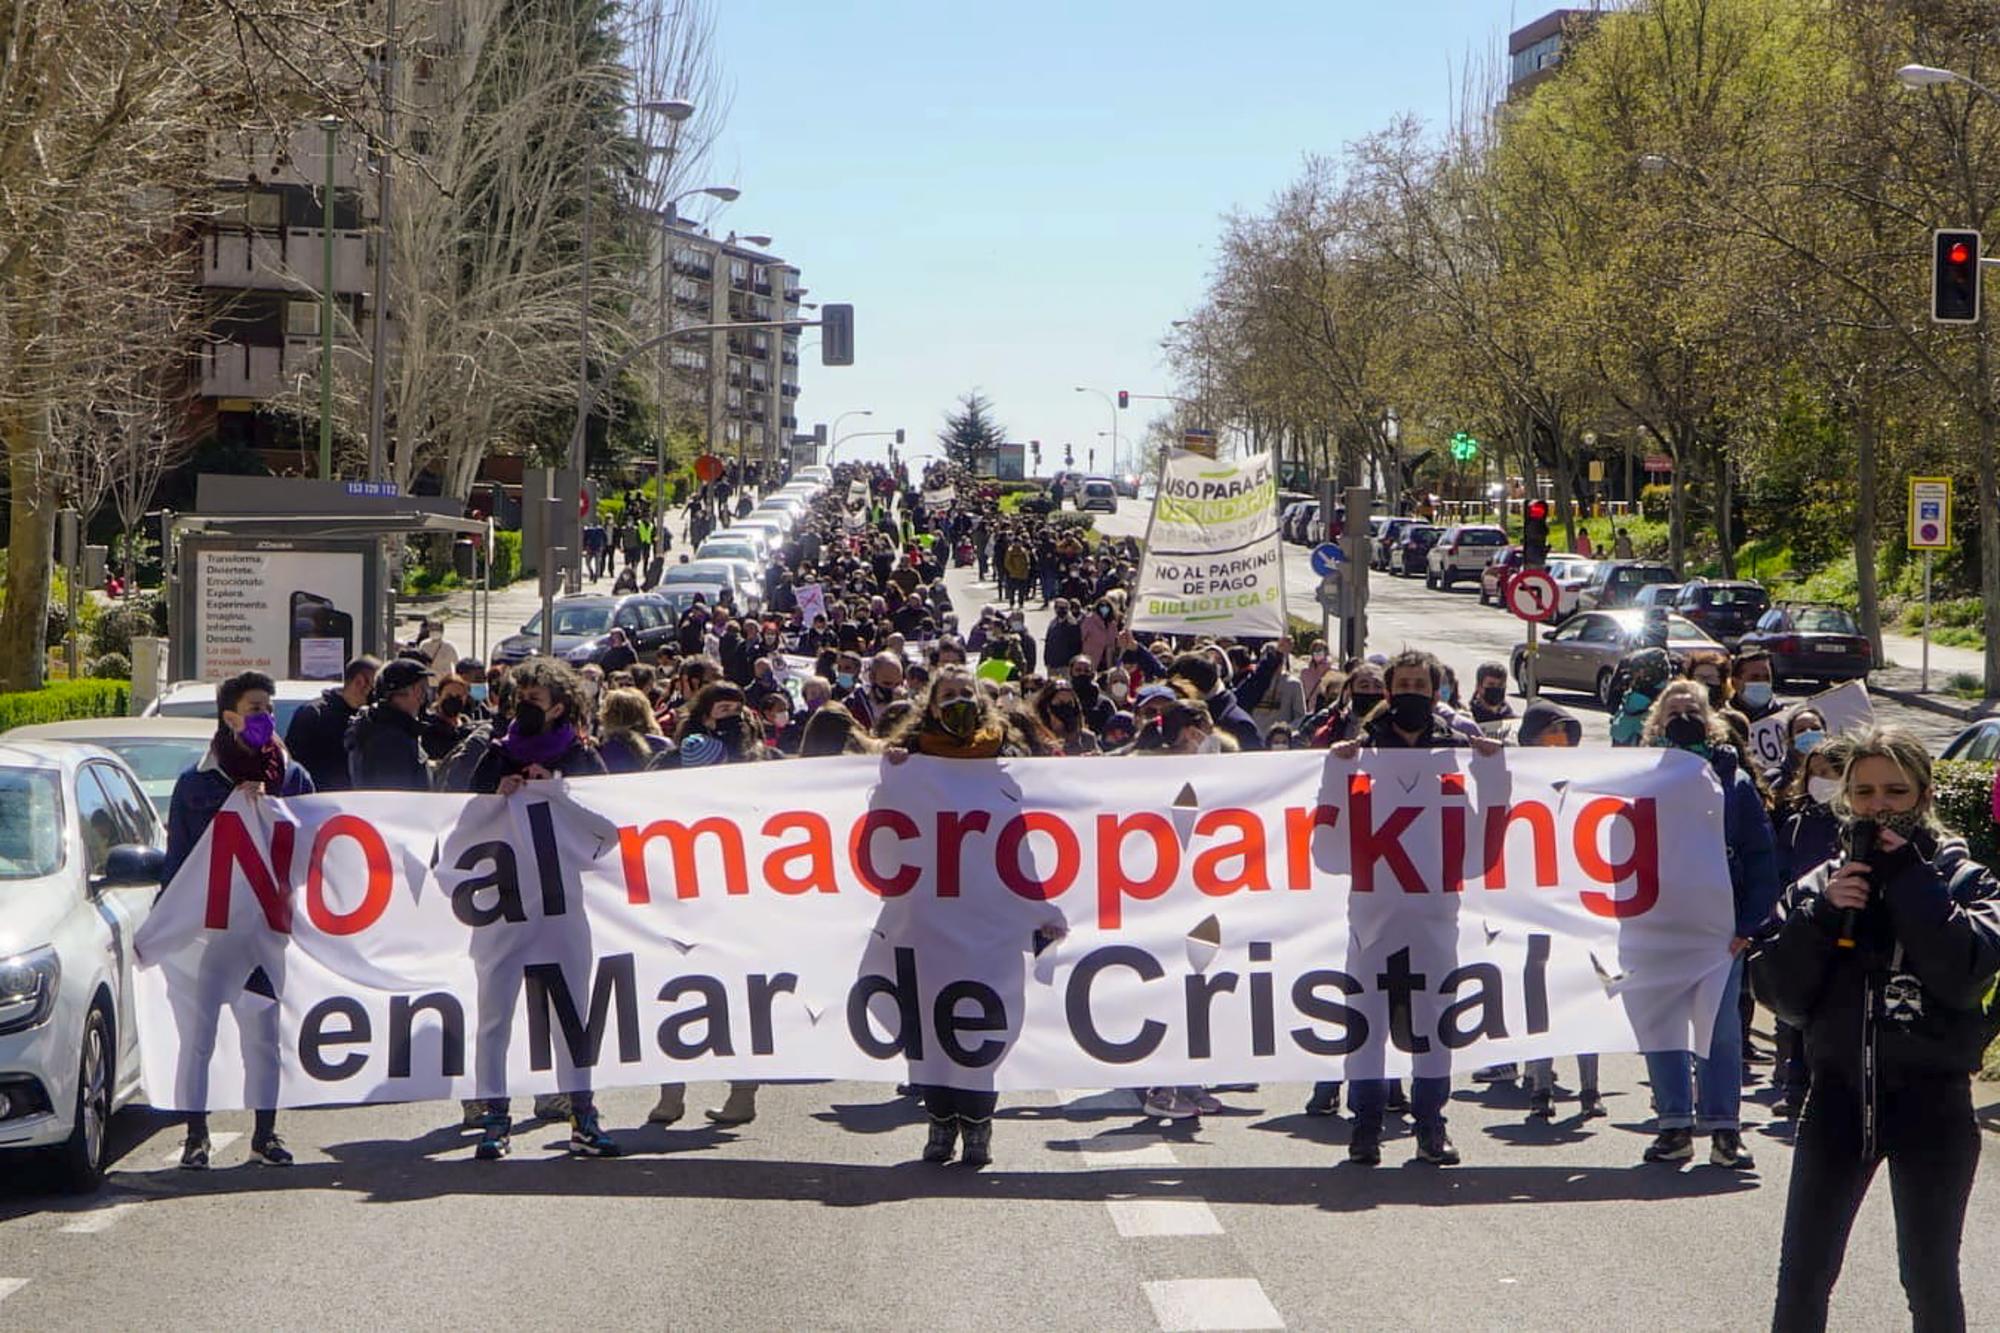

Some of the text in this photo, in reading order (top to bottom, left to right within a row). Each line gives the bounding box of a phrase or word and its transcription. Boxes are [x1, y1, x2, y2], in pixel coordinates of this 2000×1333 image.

[1165, 478, 1199, 499] USO
[1203, 475, 1254, 500] PARA
[1156, 549, 1276, 580] NO AL PARKING
[1183, 574, 1258, 595] DE PAGO
[1149, 591, 1261, 615] BIBLIOTECA
[205, 774, 1659, 936] NO al macroparking
[299, 934, 1551, 1082] en Mar de Cristal
